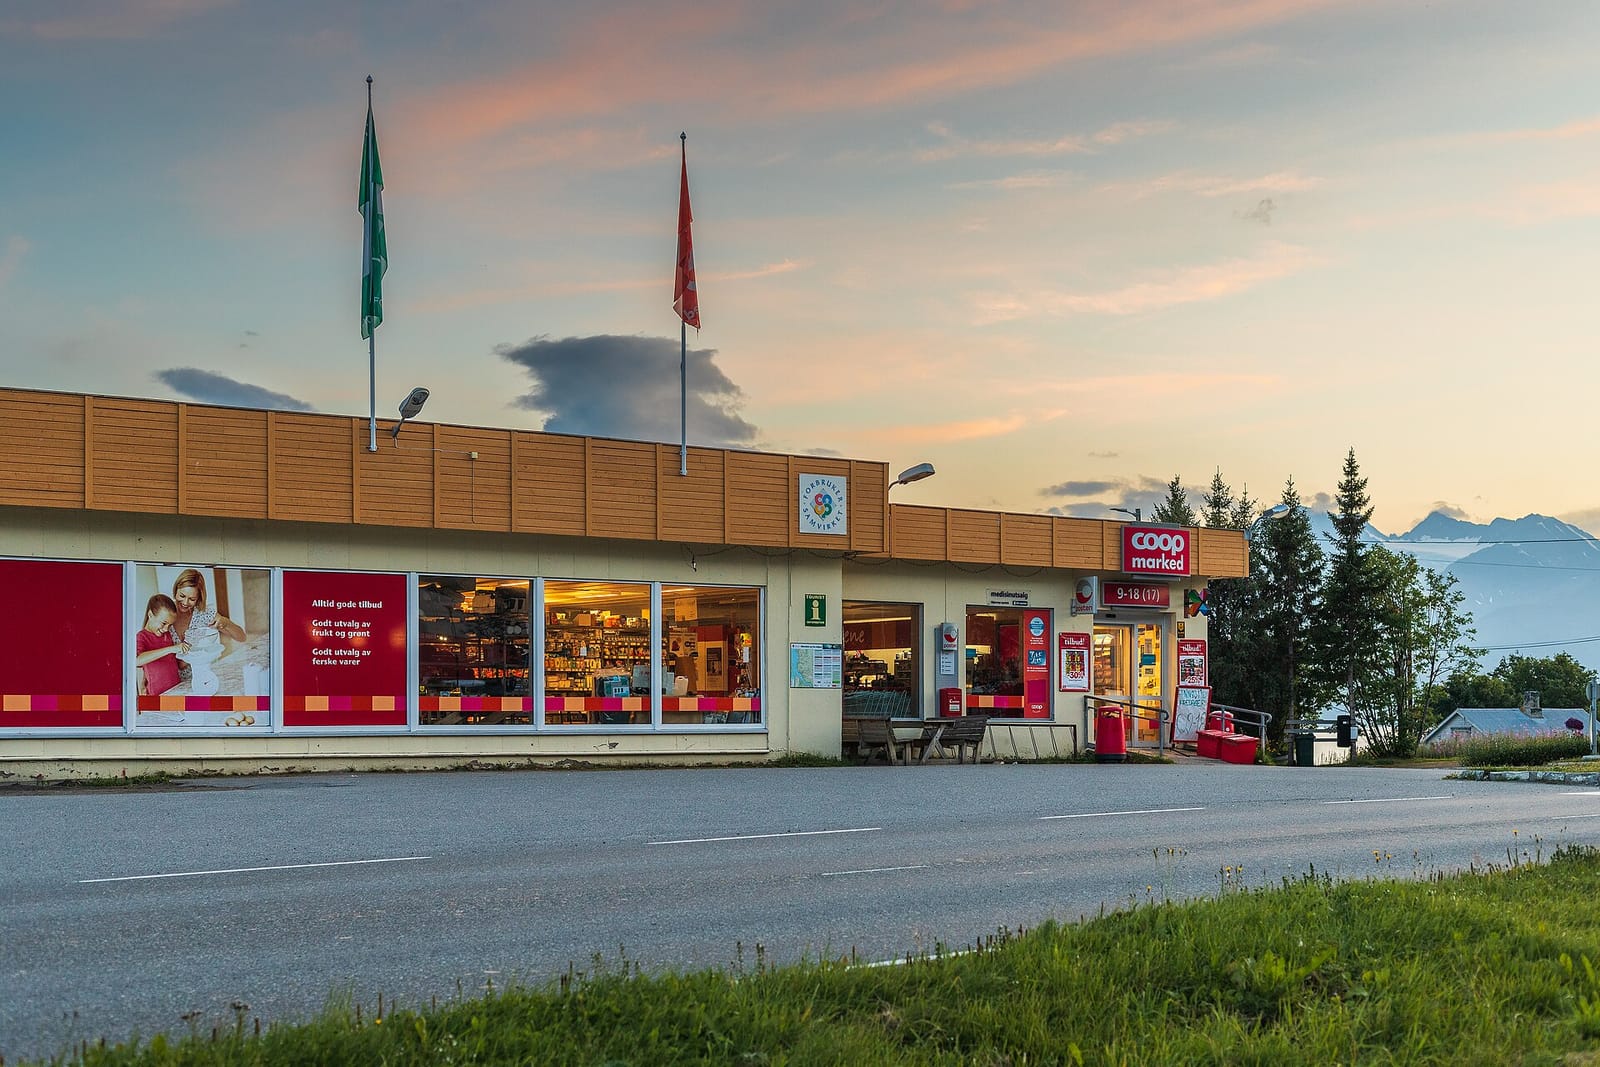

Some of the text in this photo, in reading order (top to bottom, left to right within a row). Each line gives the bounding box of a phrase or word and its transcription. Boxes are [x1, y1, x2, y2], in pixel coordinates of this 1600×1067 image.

[803, 479, 843, 502] FORBRUKER
[1131, 532, 1185, 556] coop
[1131, 553, 1184, 571] marked
[1117, 587, 1160, 602] 9-18 (17)
[312, 599, 383, 610] Alltid gode tilbud
[312, 619, 332, 627] Godt
[334, 620, 360, 629] utvalg
[312, 629, 371, 639] frukt og grønt
[312, 648, 332, 656] Godt
[334, 648, 360, 658] utvalg
[312, 658, 338, 666] ferske
